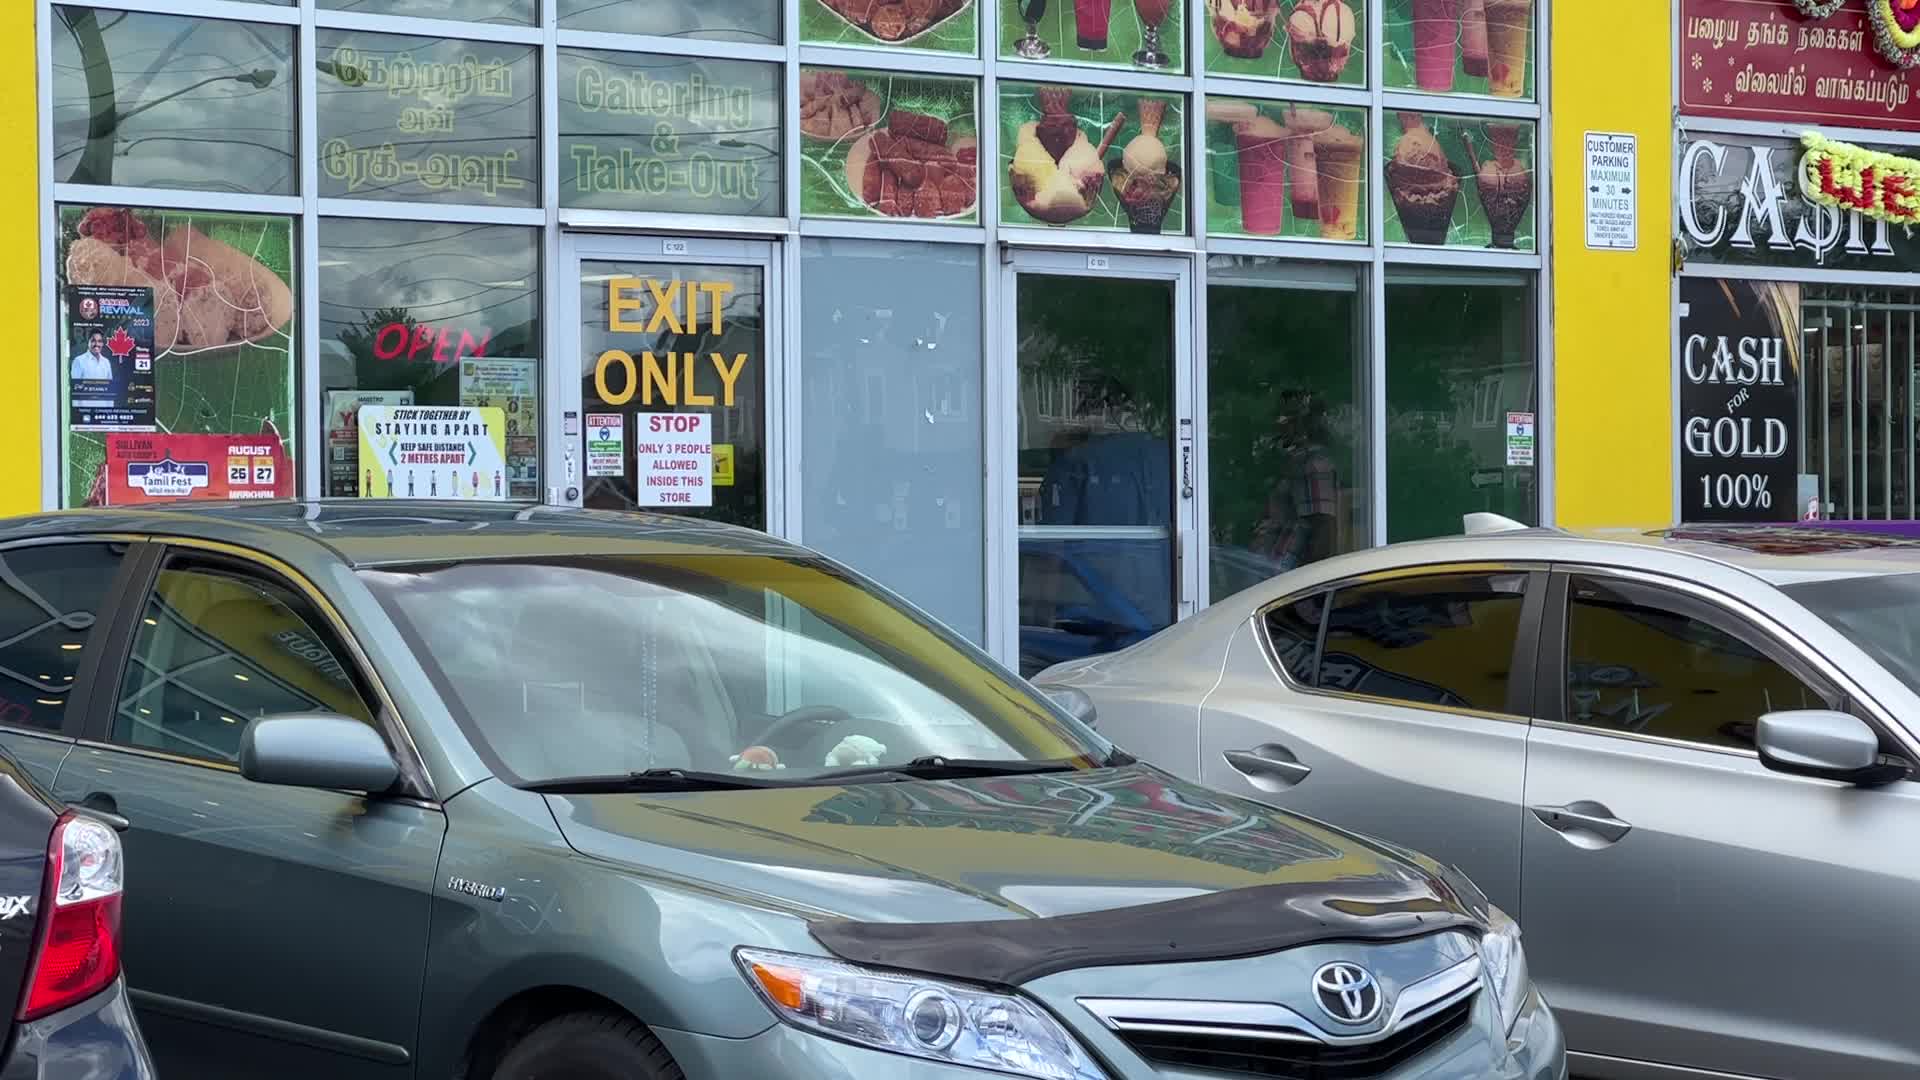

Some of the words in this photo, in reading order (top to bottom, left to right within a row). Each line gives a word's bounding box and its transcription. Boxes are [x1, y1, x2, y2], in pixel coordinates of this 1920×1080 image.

[1744, 11, 1789, 50] தங்க
[1794, 19, 1864, 54] நகைகள்
[1735, 63, 1806, 97] விலையில்
[1815, 67, 1909, 112] வாங்கப்படும்
[576, 65, 752, 129] Catering
[651, 121, 680, 157] &
[1588, 140, 1634, 154] CUSTOMER
[1592, 155, 1629, 168] PARKING
[570, 144, 760, 199] Take-Out
[1590, 169, 1631, 183] MAXIMUM
[1606, 184, 1616, 196] 30
[1592, 198, 1629, 210] MINUTES
[666, 243, 672, 251] C
[100, 306, 145, 315] REVIVAL
[609, 276, 735, 335] EXIT
[373, 322, 492, 363] OPEN
[1684, 333, 1785, 386] CASH
[594, 349, 748, 407] ONLY
[1726, 387, 1750, 414] FOR
[393, 409, 418, 421] STICK
[420, 410, 458, 421] TOGETHER
[459, 410, 471, 421] BY
[375, 423, 437, 435] STAYING
[444, 424, 488, 436] APART
[650, 415, 700, 432] STOP
[1684, 416, 1788, 458] GOLD
[228, 446, 271, 456] AUGUST
[400, 442, 416, 452] KEEP
[417, 443, 432, 452] SAFE
[434, 443, 465, 452] DISTANCE
[639, 444, 664, 454] ONLY
[666, 444, 673, 454] 3
[675, 444, 711, 454] PEOPLE
[401, 454, 406, 464] 2
[407, 454, 439, 464] METRES
[440, 454, 465, 464] APART
[653, 460, 698, 471] ALLOWED
[231, 468, 246, 480] 26
[257, 468, 272, 480] 27
[143, 476, 169, 486] Tamil
[171, 476, 192, 486] Fest
[646, 476, 678, 486] INSIDE
[681, 476, 703, 486] THIS
[660, 493, 691, 503] STORE
[1701, 474, 1772, 509] 100%
